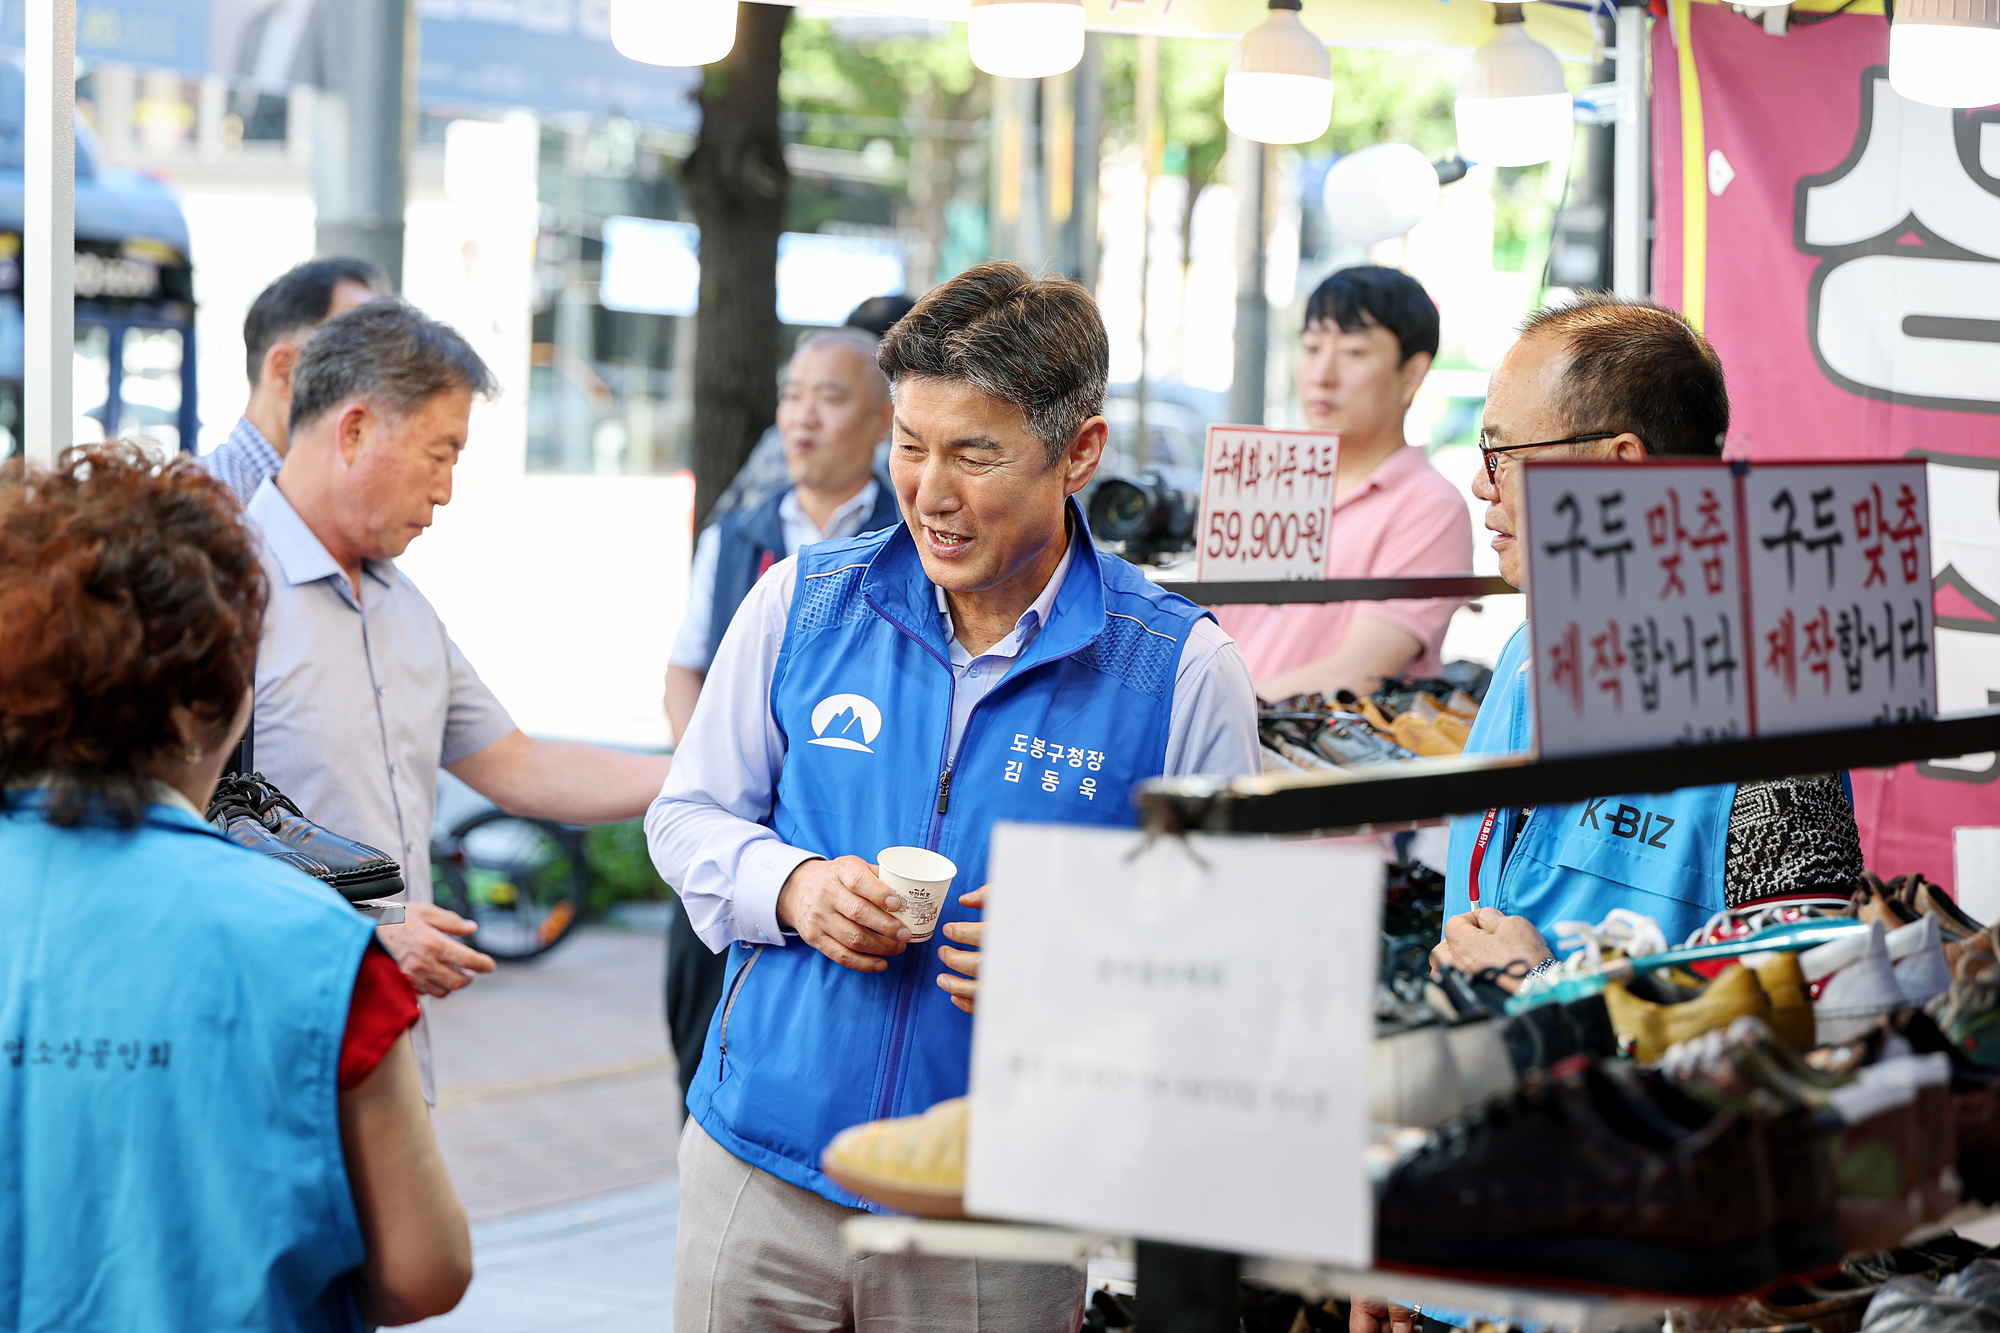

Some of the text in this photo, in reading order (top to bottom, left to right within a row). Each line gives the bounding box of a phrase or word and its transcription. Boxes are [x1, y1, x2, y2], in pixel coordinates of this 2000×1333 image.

[1208, 508, 1325, 563] 59,900원
[1542, 487, 1729, 598] 구두 맞춤
[1761, 487, 1843, 590] 구두
[1852, 482, 1923, 588] 맞춤
[1010, 733, 1105, 771] 도봉구청장
[1579, 797, 1675, 849] K-BIZ
